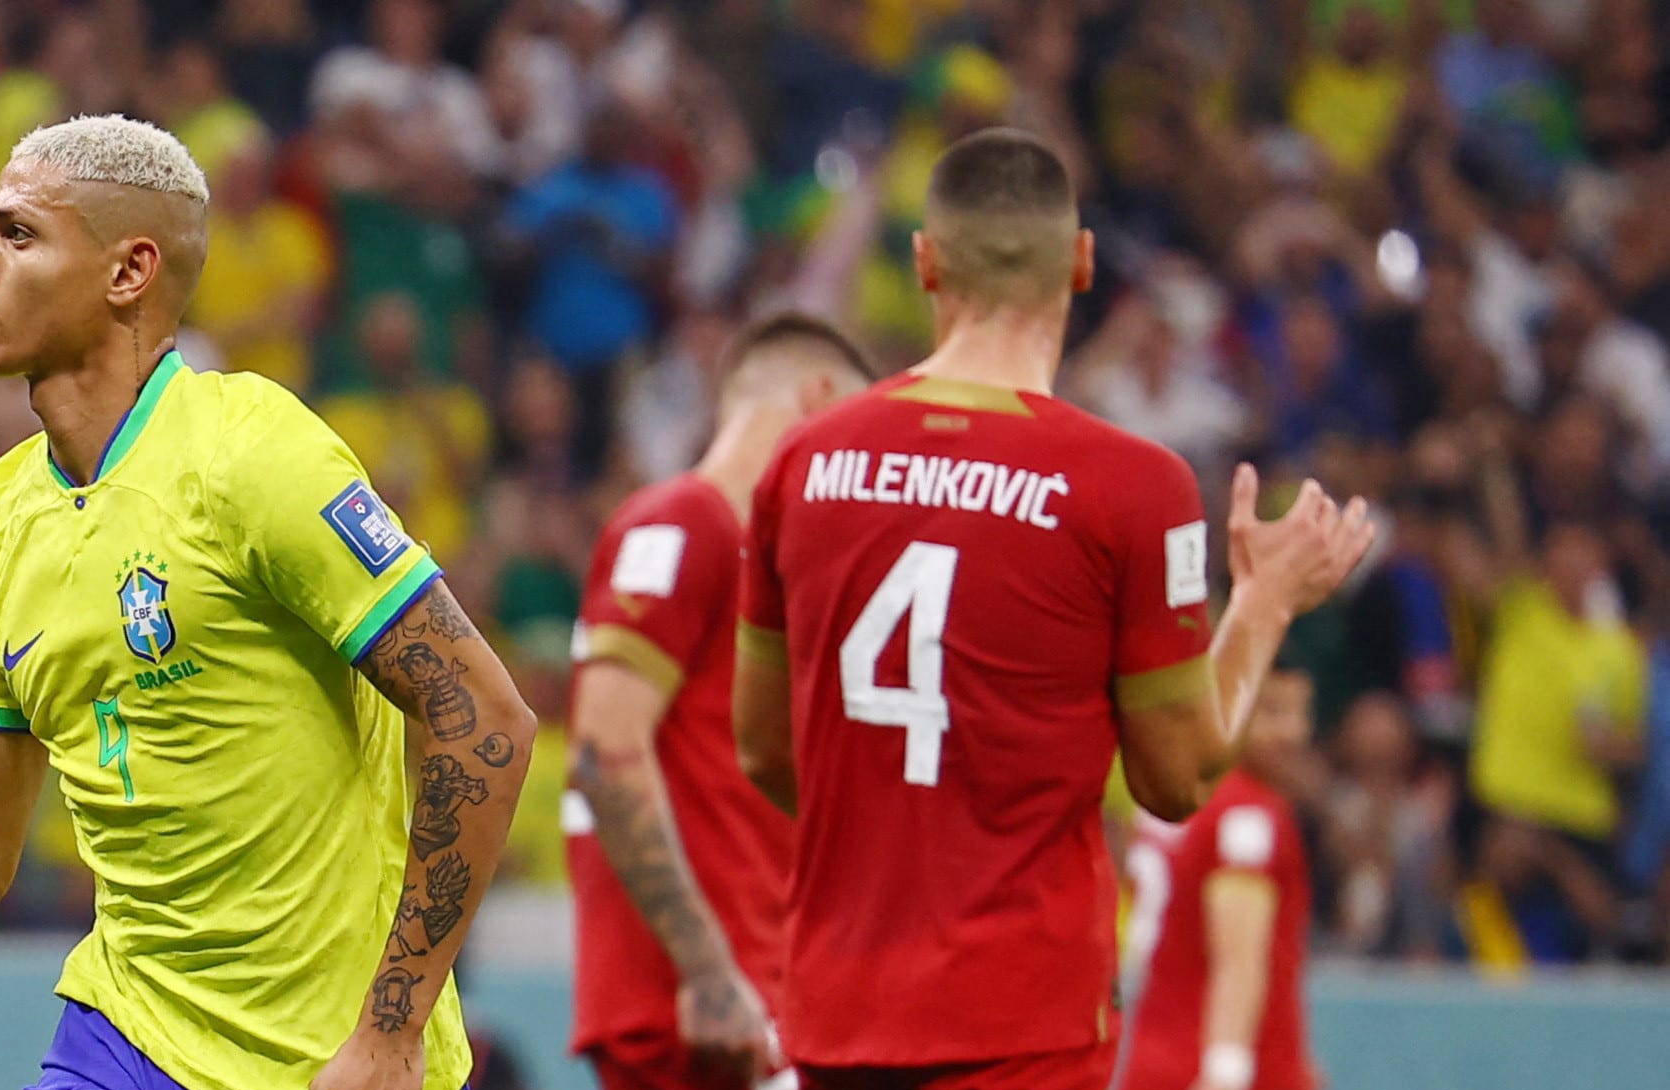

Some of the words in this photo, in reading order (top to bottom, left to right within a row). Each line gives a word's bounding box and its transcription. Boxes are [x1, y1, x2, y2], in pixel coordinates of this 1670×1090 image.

[804, 450, 1069, 529] MILENKOVIĆ
[133, 606, 152, 621] CBF
[135, 659, 202, 690] BRASIL
[839, 541, 958, 786] 4
[93, 696, 134, 802] 9
